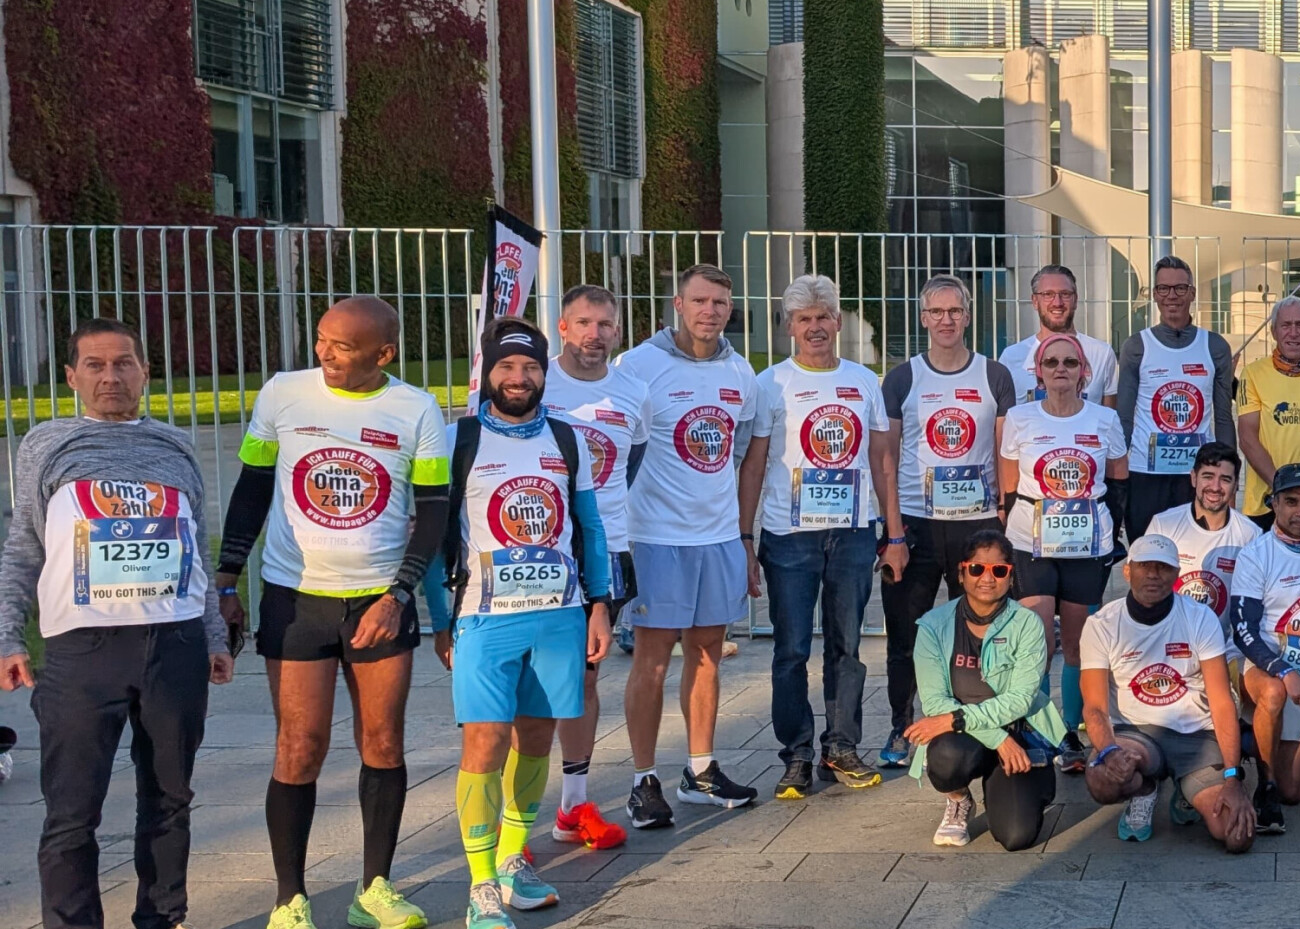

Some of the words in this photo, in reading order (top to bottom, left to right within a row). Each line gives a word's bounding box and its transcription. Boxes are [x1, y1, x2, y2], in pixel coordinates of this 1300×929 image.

[820, 406, 839, 416] LAUFE
[1164, 401, 1188, 412] Oma
[822, 420, 843, 429] Jede
[938, 425, 960, 436] Oma
[691, 430, 721, 443] Oma
[816, 428, 843, 442] Oma
[306, 453, 323, 466] ICH
[325, 450, 356, 461] LAUFE
[1161, 448, 1196, 459] 22714
[1056, 461, 1079, 469] Jede
[1049, 468, 1079, 480] Oma
[314, 473, 361, 490] Oma
[100, 481, 147, 499] Oma
[498, 484, 513, 498] ICH
[512, 478, 538, 489] LAUFE
[808, 487, 847, 499] 13756
[942, 482, 976, 494] 5344
[321, 492, 365, 507] zählt
[516, 494, 544, 506] Jede
[306, 508, 377, 528] www.helpage.de
[507, 505, 545, 521] Oma
[1046, 516, 1088, 528] 13089
[99, 542, 170, 561] 12379
[122, 564, 151, 573] Oliver
[499, 565, 561, 582] 66265
[93, 591, 112, 599] YOU
[116, 589, 134, 598] GOT
[137, 587, 156, 597] THIS
[493, 600, 508, 609] YOU
[511, 599, 526, 608] GOT
[527, 599, 544, 607] THIS
